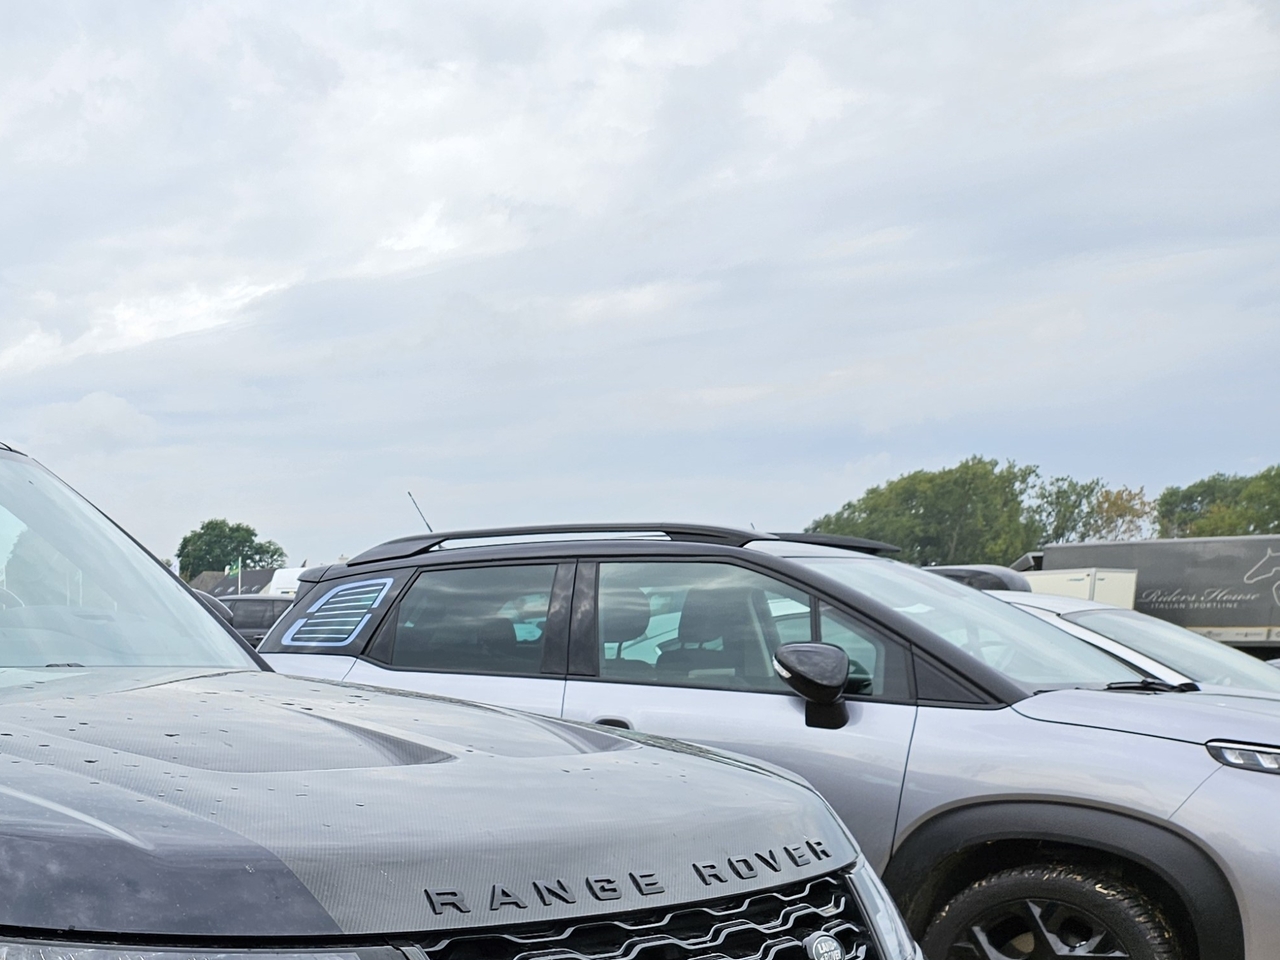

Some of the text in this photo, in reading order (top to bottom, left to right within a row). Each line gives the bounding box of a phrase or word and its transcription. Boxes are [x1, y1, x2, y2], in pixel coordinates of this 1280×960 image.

[1138, 588, 1260, 602] Riders House
[423, 838, 832, 915] RANGE ROVER
[817, 941, 837, 954] LAND
